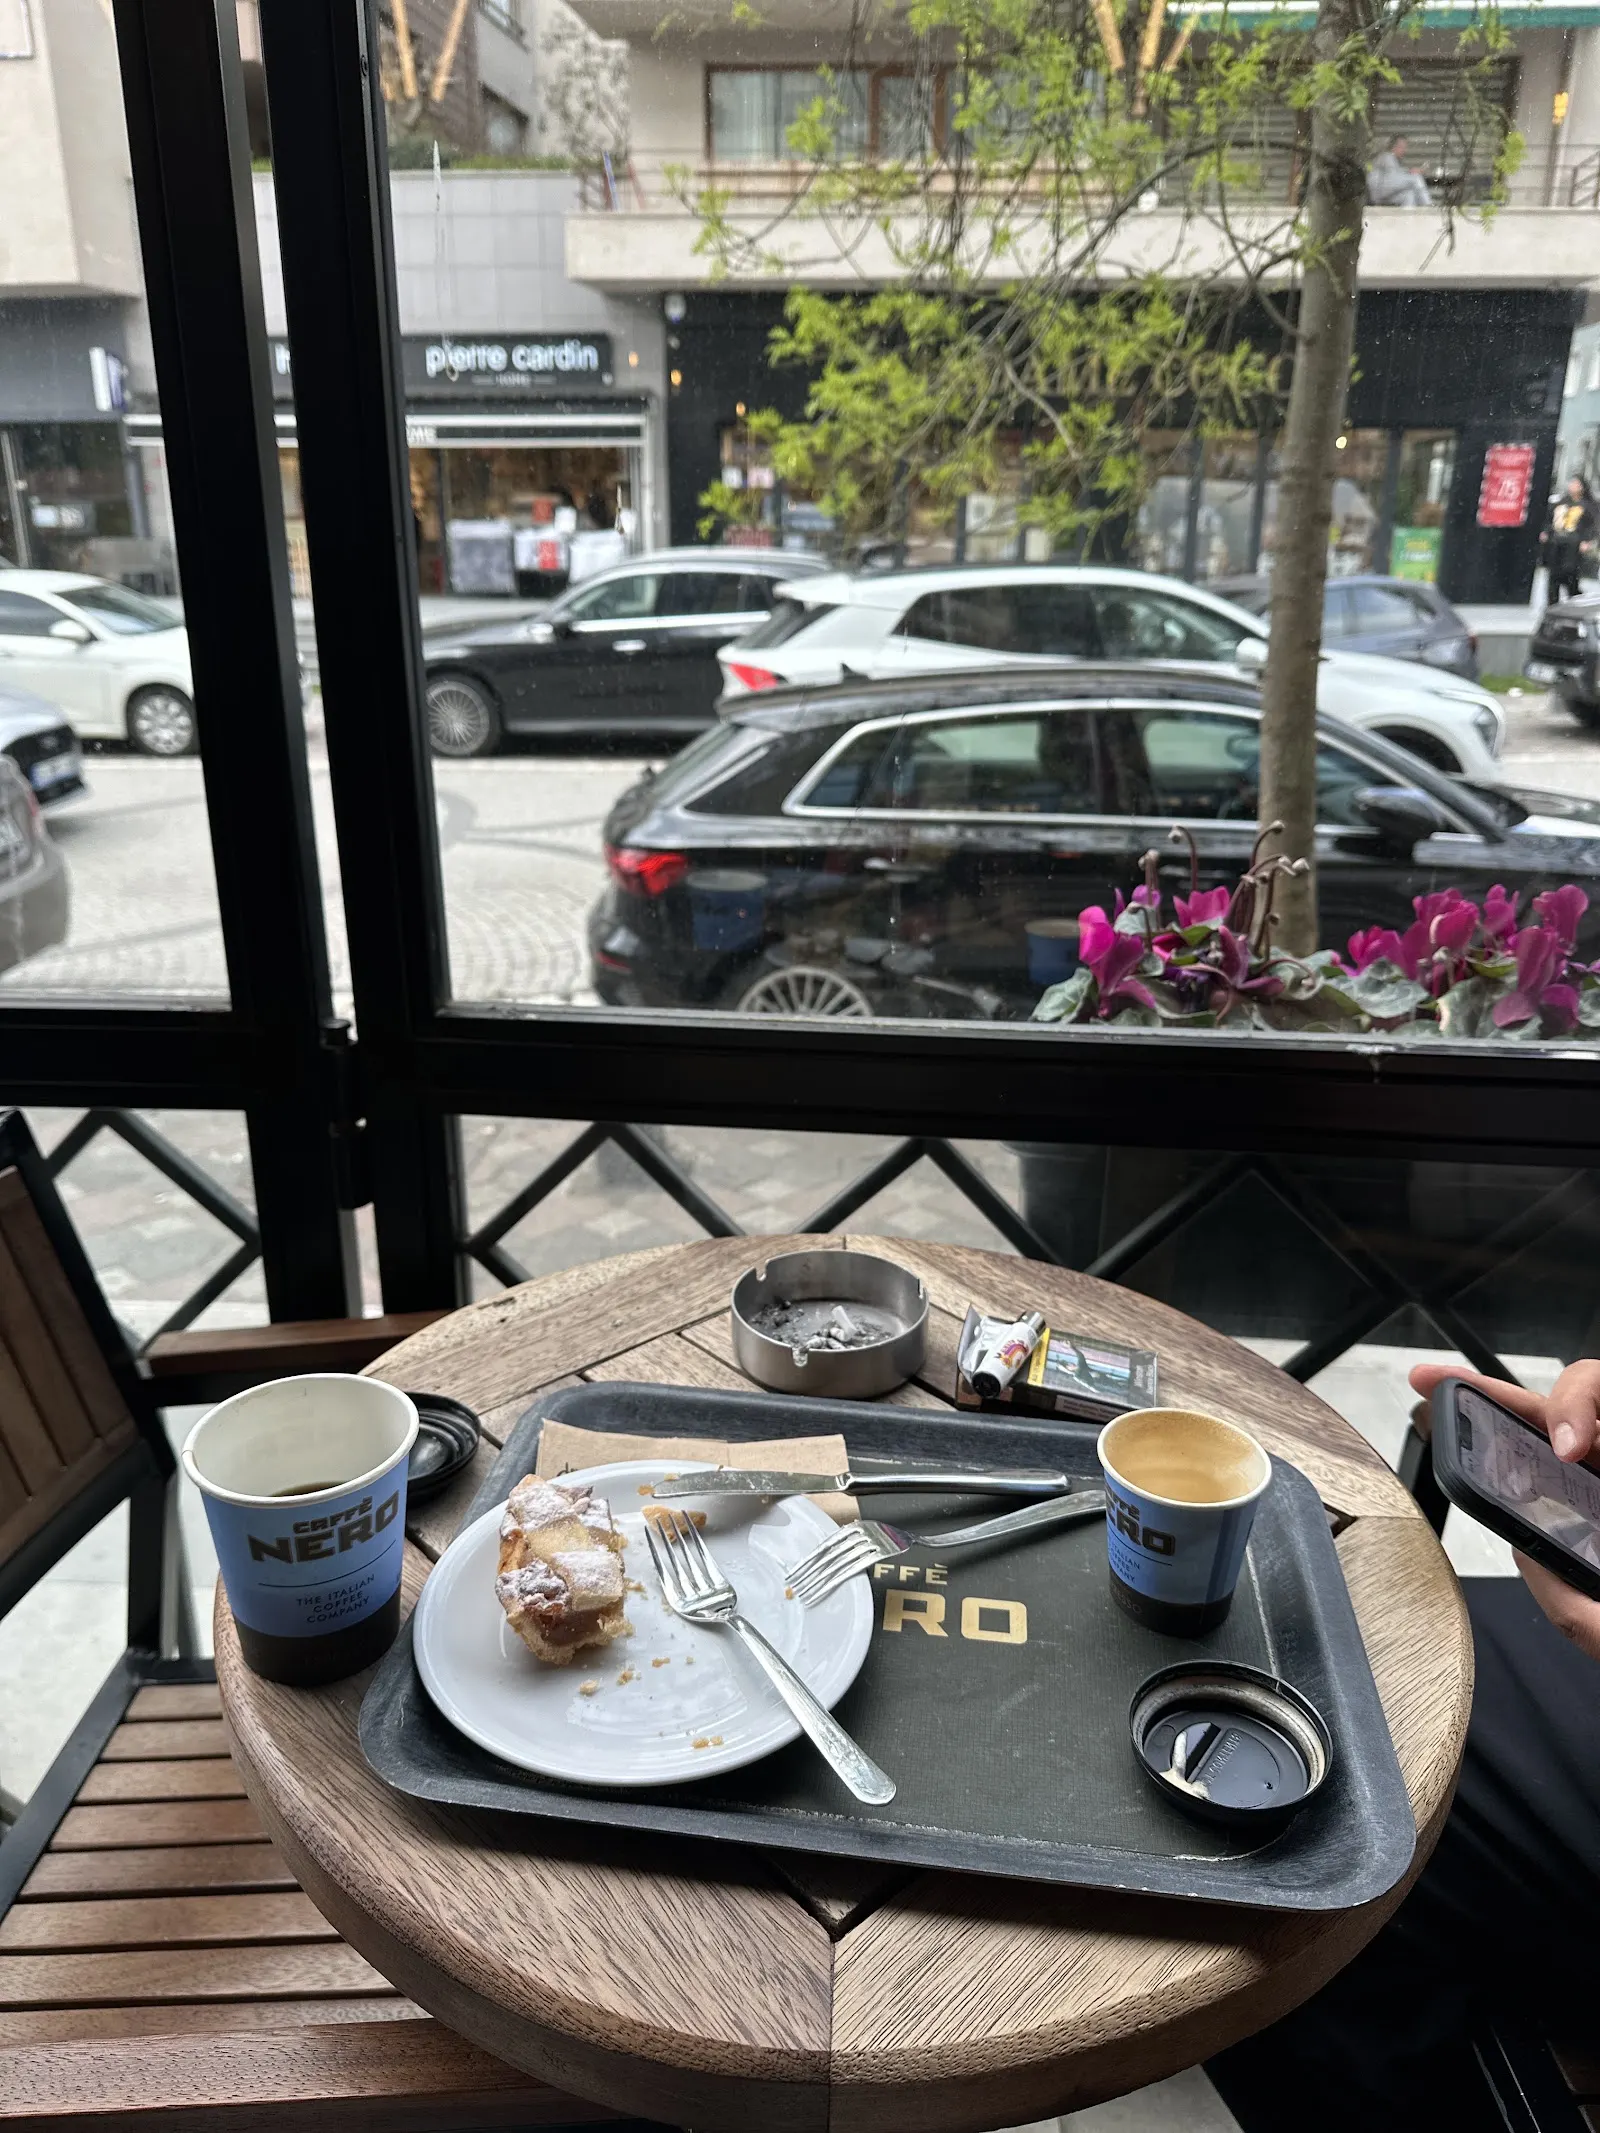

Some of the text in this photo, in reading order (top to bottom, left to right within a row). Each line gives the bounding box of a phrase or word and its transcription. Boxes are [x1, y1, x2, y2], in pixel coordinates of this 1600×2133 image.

[425, 339, 600, 377] pierre cardin
[247, 1489, 400, 1565] NERO
[296, 1573, 375, 1607] THE ITALIAN
[873, 1563, 949, 1586] FFÈ
[306, 1595, 370, 1624] COMPANY
[313, 1590, 364, 1613] COFFEE
[882, 1588, 1028, 1645] RO
